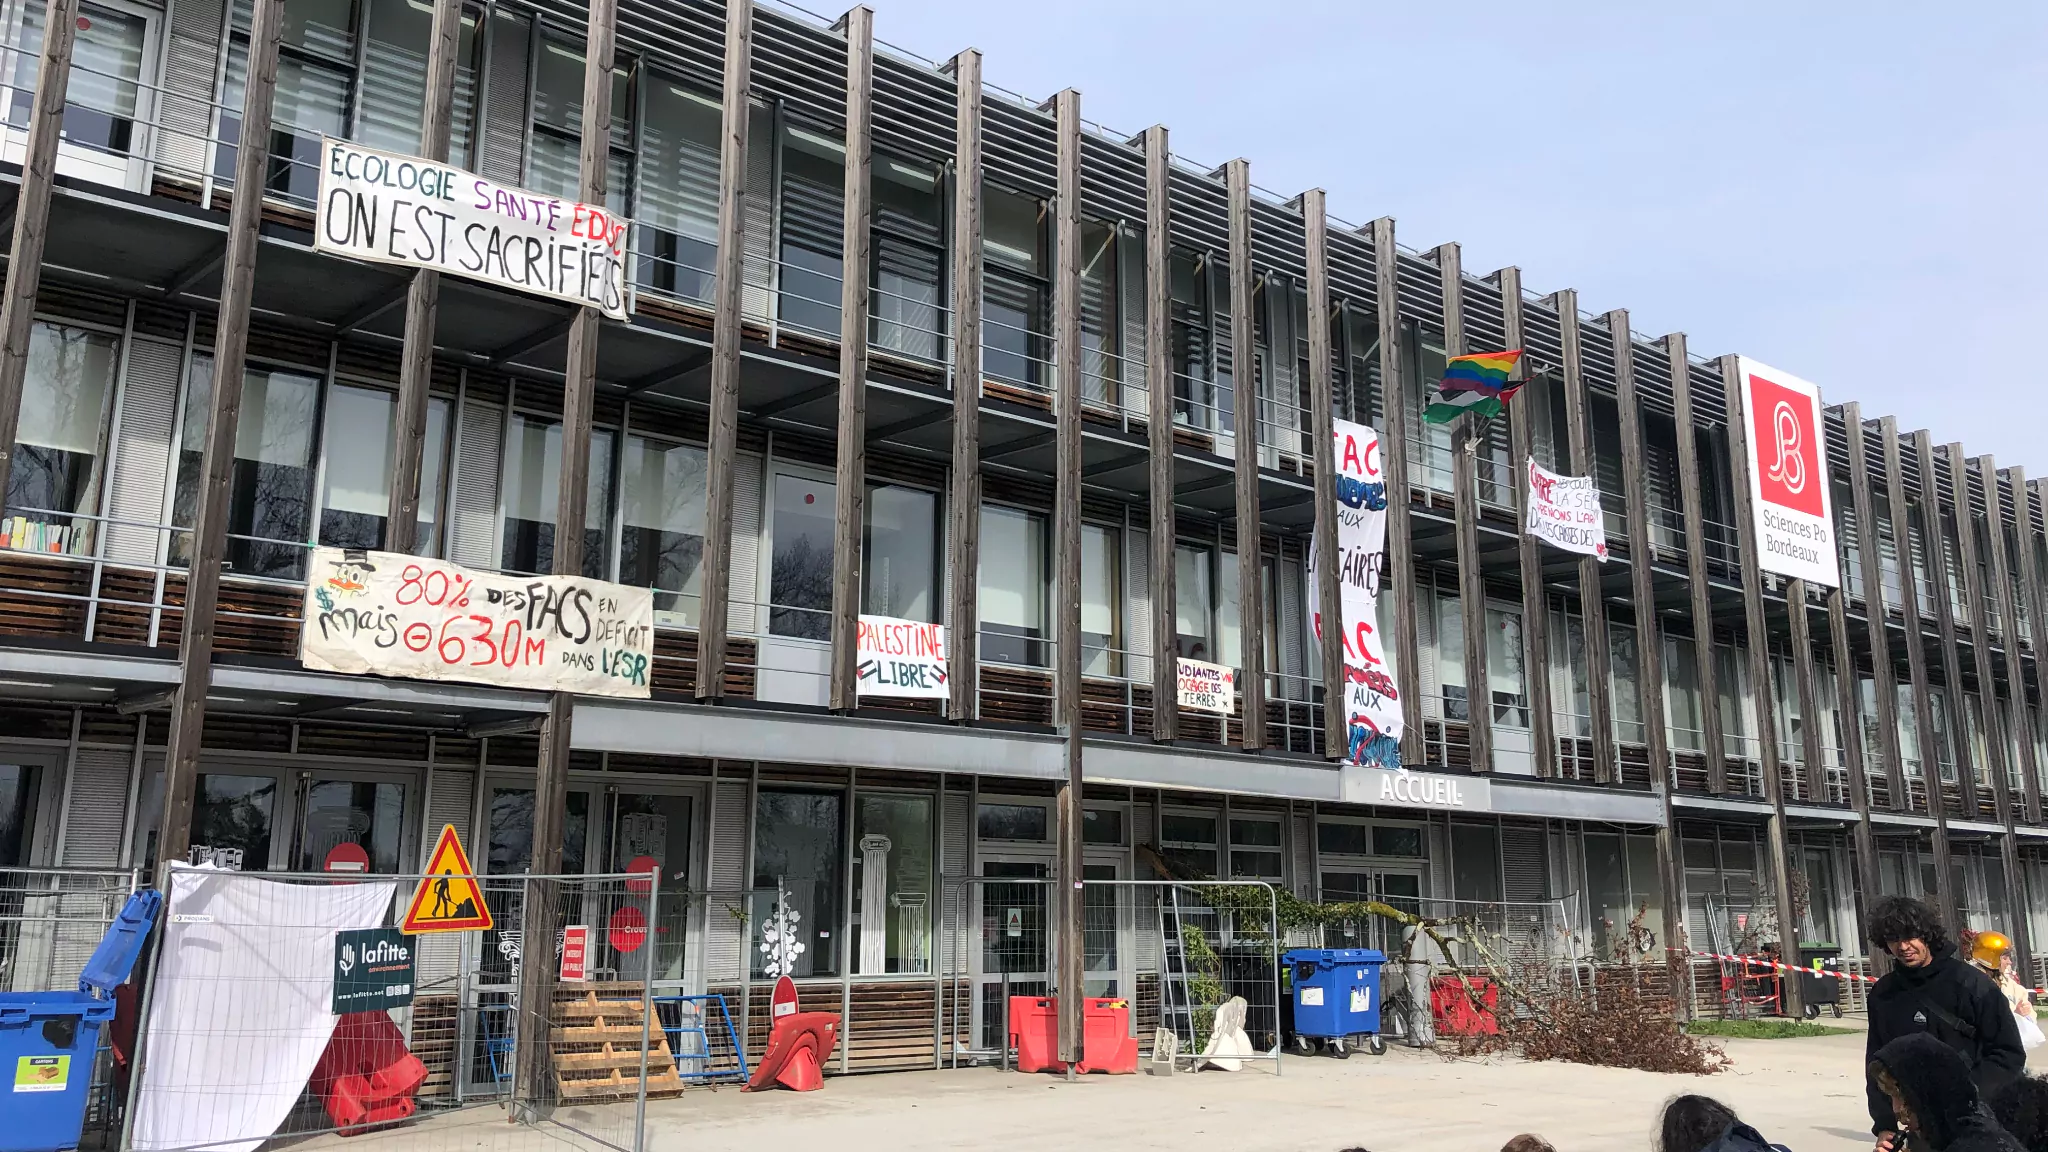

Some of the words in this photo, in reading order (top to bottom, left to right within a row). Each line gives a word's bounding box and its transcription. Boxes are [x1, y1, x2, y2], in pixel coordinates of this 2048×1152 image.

[331, 144, 457, 202] ÉCOLOGIE
[474, 181, 561, 232] SANTÉ
[571, 203, 625, 256] ÉDUC
[326, 188, 376, 249] ON
[389, 201, 455, 264] EST
[1334, 431, 1379, 476] AC
[1556, 492, 1569, 507] LA
[1337, 510, 1364, 530] AUX
[1763, 508, 1811, 539] Sciences
[1813, 523, 1827, 543] Po
[1766, 533, 1820, 565] Bordeaux
[396, 564, 473, 608] 80%
[487, 587, 526, 611] DES
[526, 582, 593, 644] FACS
[598, 598, 618, 615] EN
[562, 650, 594, 671] DANS
[877, 660, 933, 689] LIBRE
[1184, 692, 1217, 708] TERRES
[1353, 687, 1382, 712] AUX
[1380, 773, 1464, 807] ACCUEIL
[624, 925, 648, 934] Crous
